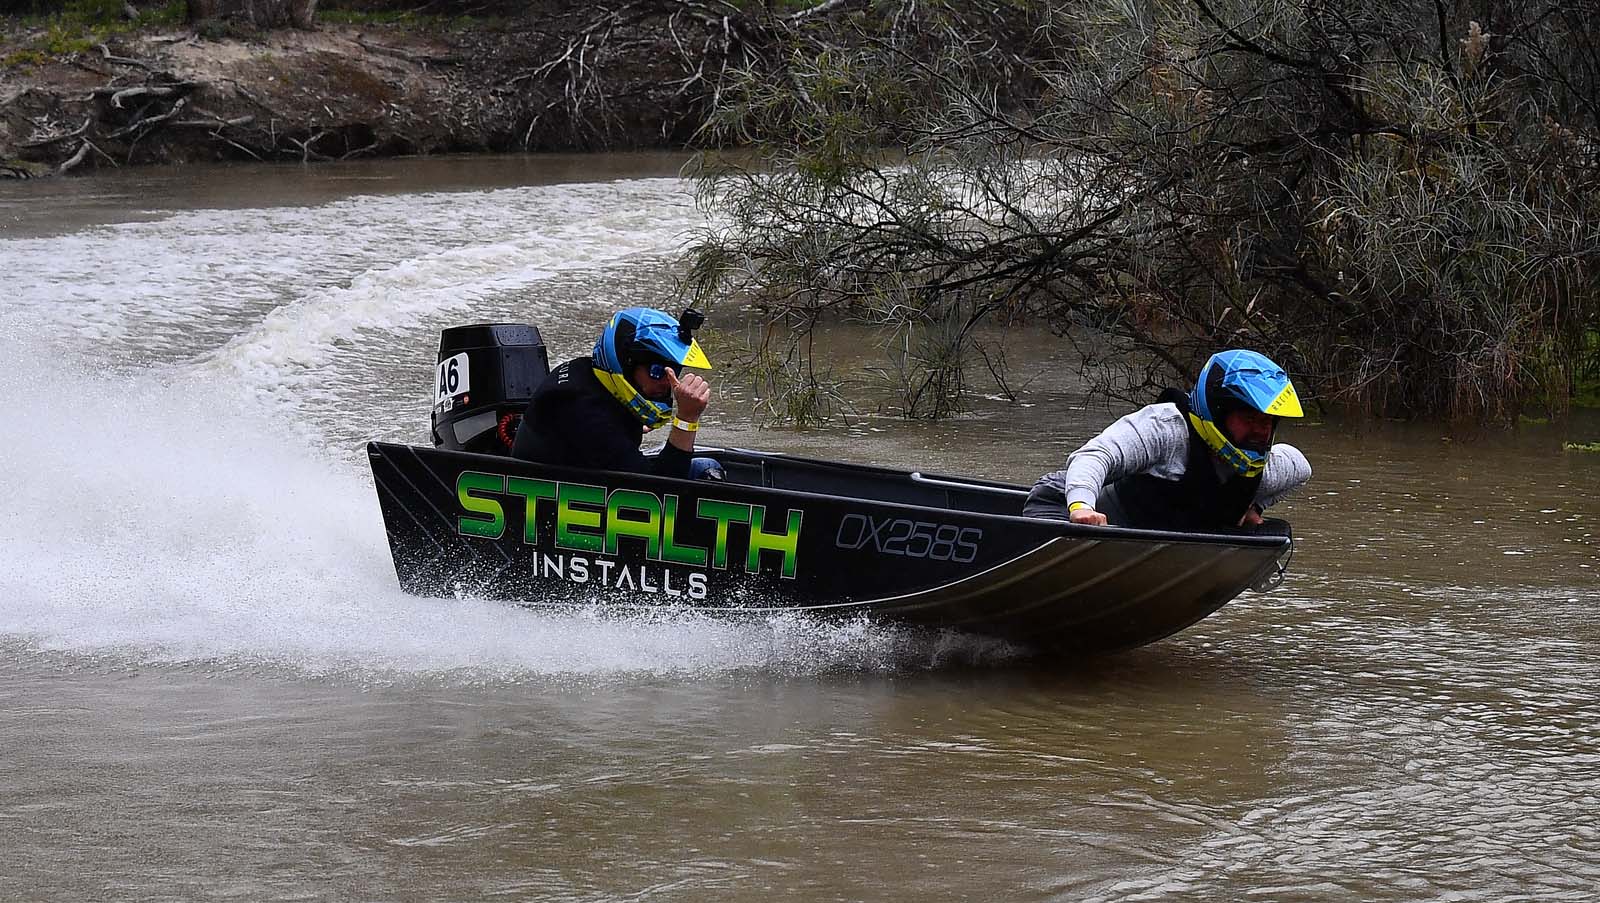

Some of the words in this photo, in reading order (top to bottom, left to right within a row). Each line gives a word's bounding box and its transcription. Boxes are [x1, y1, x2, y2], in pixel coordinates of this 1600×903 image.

[439, 357, 460, 399] A6
[456, 470, 804, 580] STEALTH
[533, 551, 709, 599] INSTALLS
